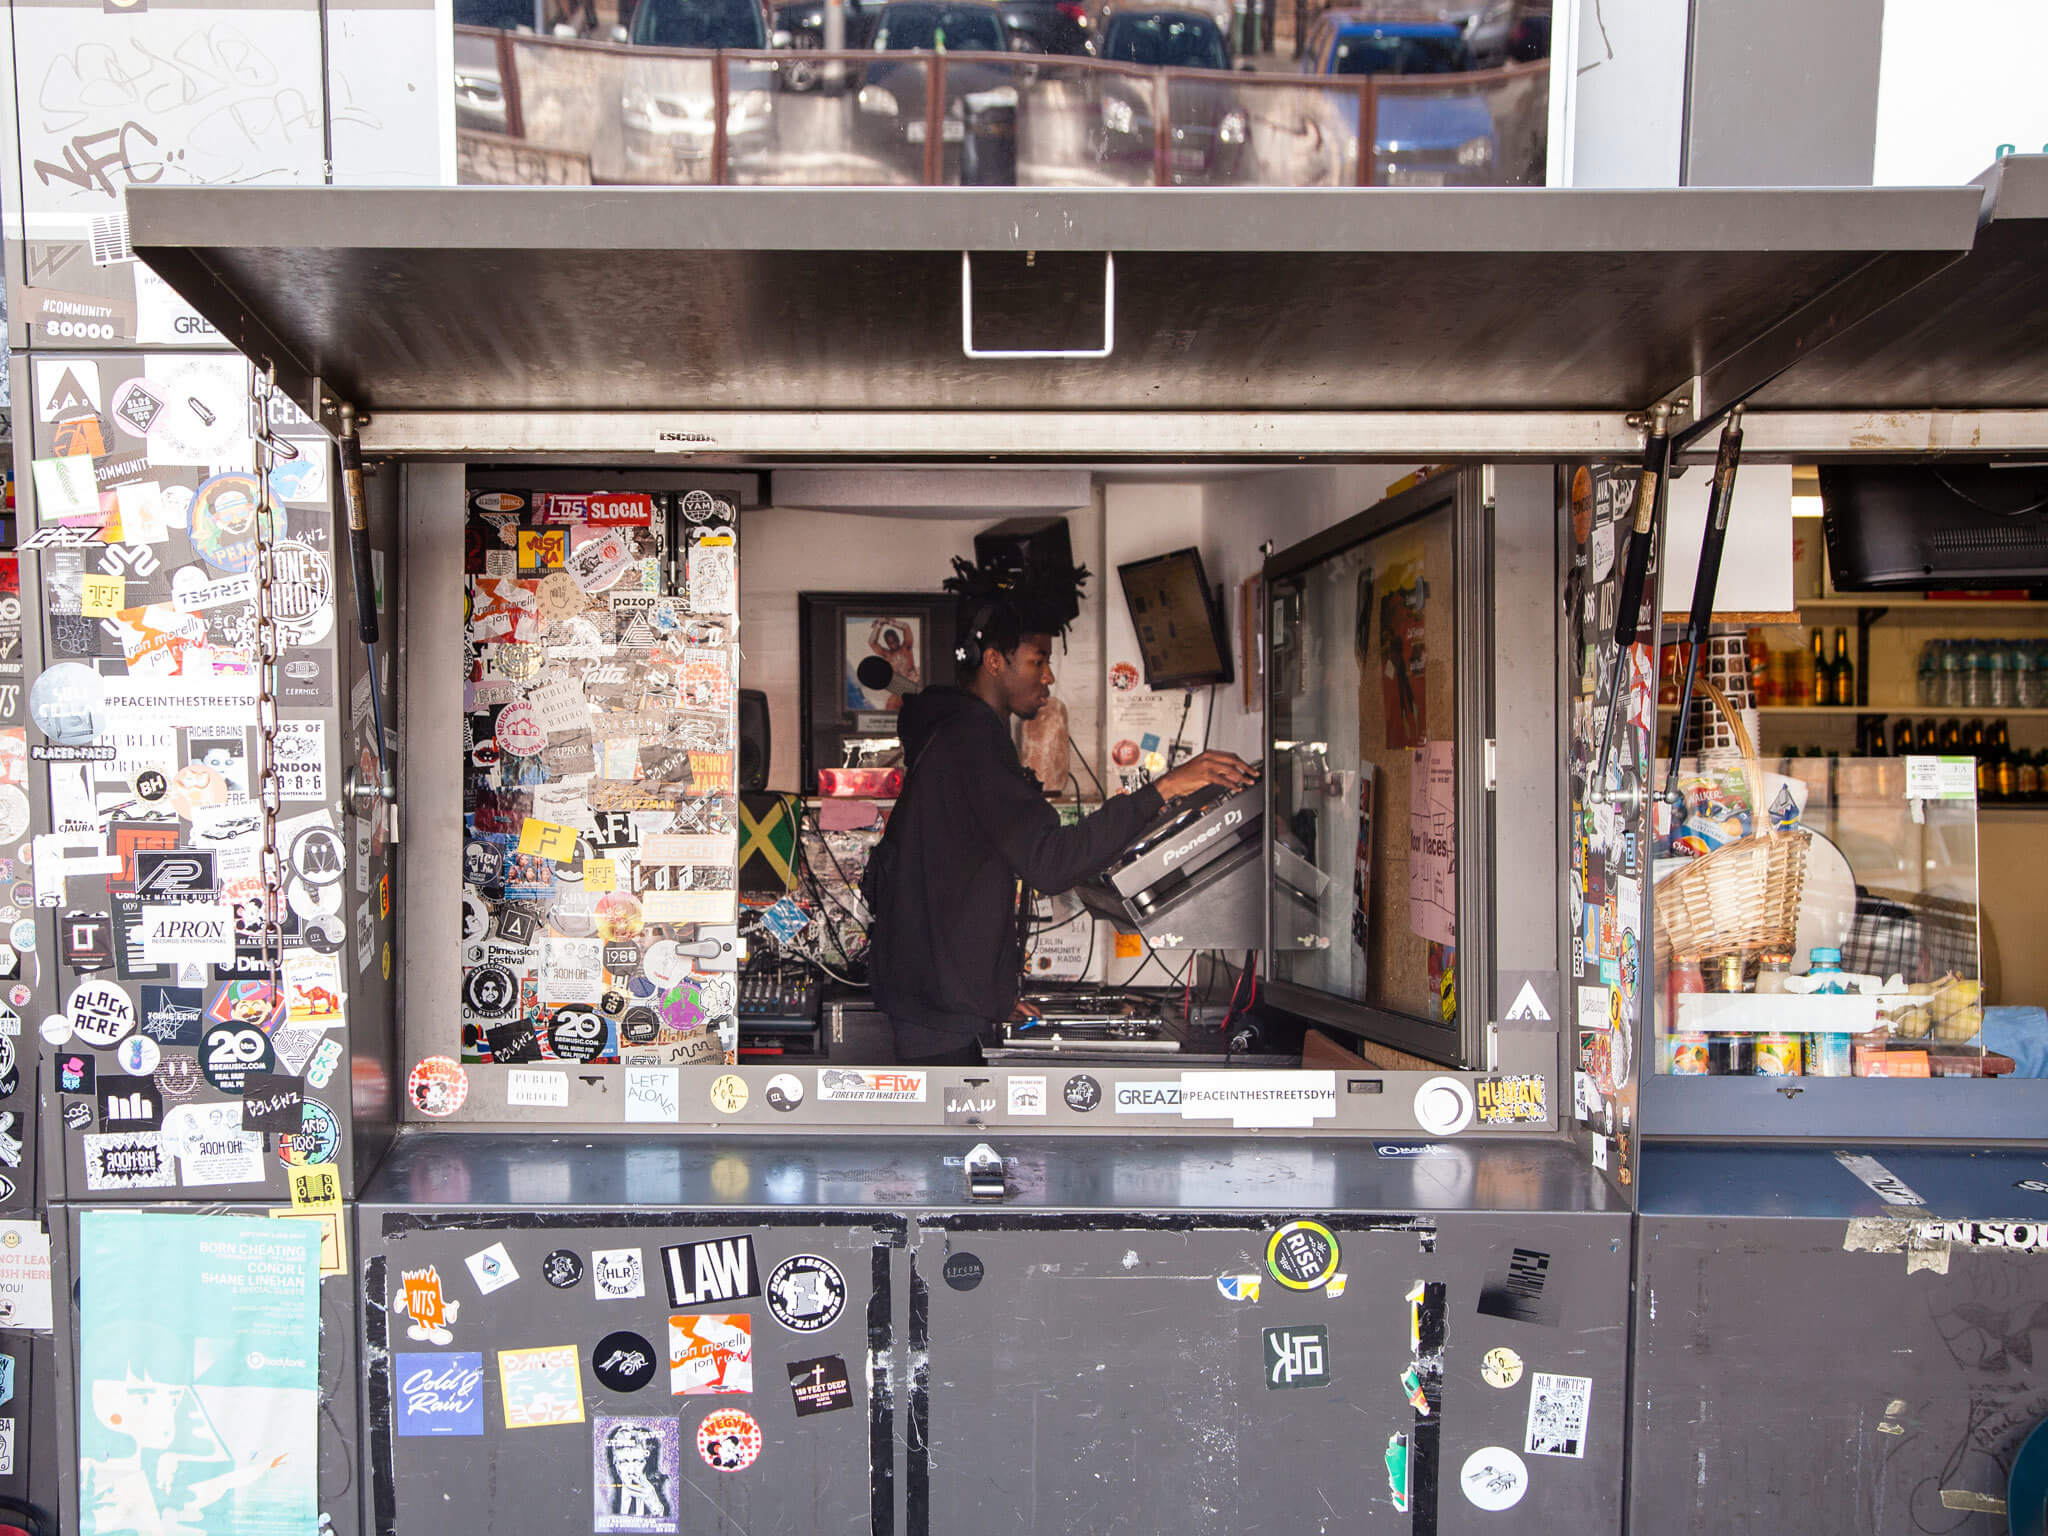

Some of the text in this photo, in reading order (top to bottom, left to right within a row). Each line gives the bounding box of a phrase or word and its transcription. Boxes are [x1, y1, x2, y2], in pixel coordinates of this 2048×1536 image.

[43, 299, 112, 317] #COMMUNITY
[687, 502, 710, 510] YAM
[614, 598, 655, 608] pazop
[105, 697, 256, 707] #PEACEINTHESTREETSD
[190, 725, 243, 737] RICHIE BRAINS
[305, 724, 320, 732] OF
[271, 763, 321, 772] ONDON
[139, 775, 164, 796] BH
[1162, 820, 1222, 866] Pioneer
[152, 921, 225, 938] APRON
[74, 992, 129, 1019] BLACK
[178, 1012, 199, 1021] ECHO
[556, 1011, 601, 1038] 20
[75, 1014, 119, 1037] ACRE
[207, 1030, 265, 1063] 20
[630, 1074, 669, 1087] LEFT
[872, 1074, 921, 1092] FTW
[868, 1091, 876, 1100] TO
[1478, 1080, 1544, 1106] HUMAN
[628, 1088, 676, 1116] ALONE
[200, 1242, 306, 1257] BORN CHEATING
[1287, 1233, 1320, 1278] RISE
[248, 1262, 295, 1275] CONOR
[606, 1268, 630, 1279] HLR
[668, 1238, 749, 1306] LAW
[202, 1272, 305, 1288] SHANE LINEHAN
[412, 1290, 436, 1317] NTS
[675, 1332, 746, 1360] ron morelli
[695, 1357, 713, 1374] jon
[402, 1366, 468, 1395] Cold
[827, 1379, 847, 1391] DEEP
[408, 1392, 474, 1416] Rain
